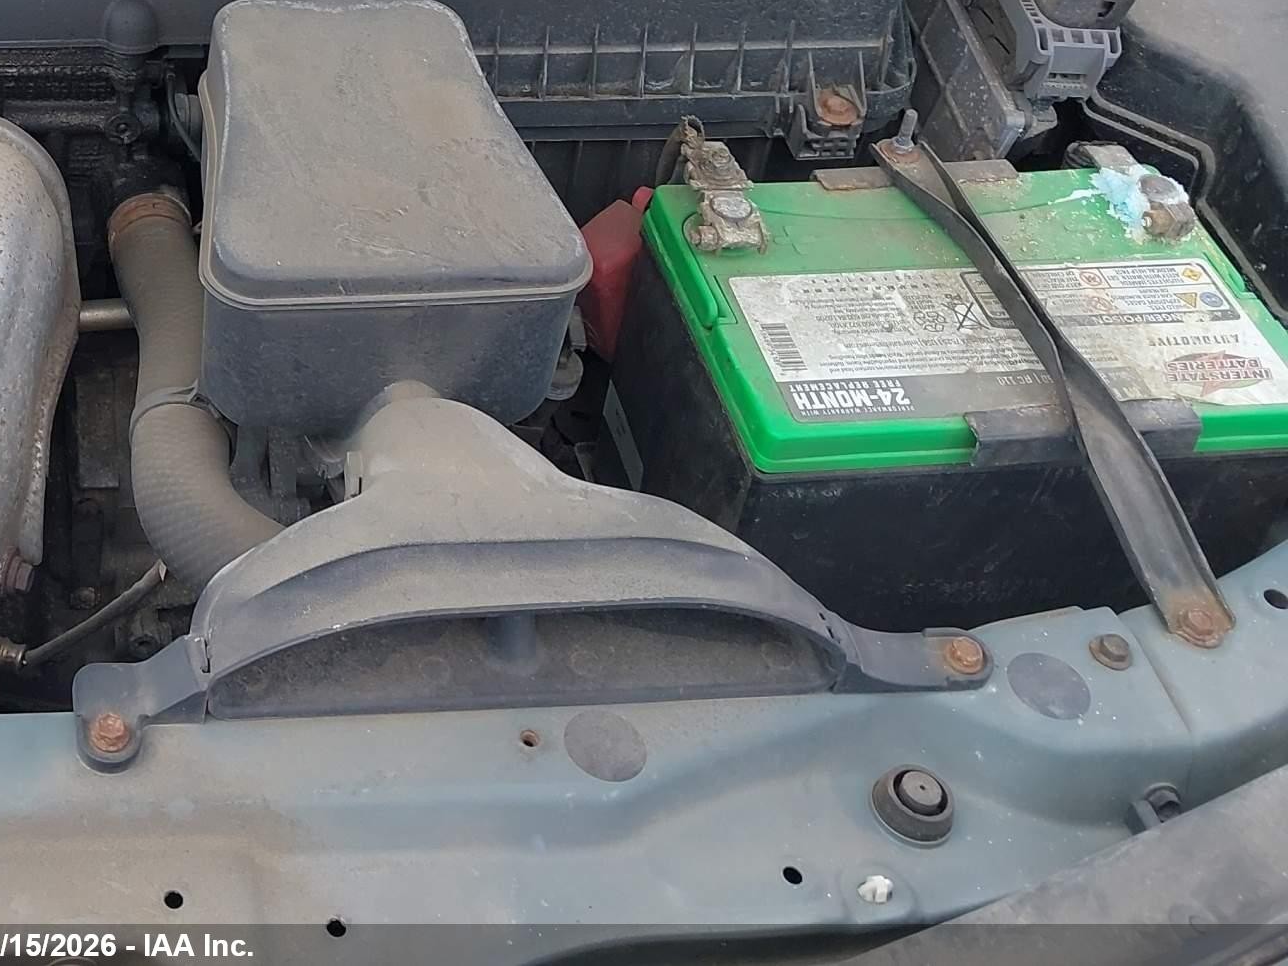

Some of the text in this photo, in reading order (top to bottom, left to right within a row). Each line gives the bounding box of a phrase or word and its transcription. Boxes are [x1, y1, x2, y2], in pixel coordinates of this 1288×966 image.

[1148, 333, 1240, 347] AUTOMOTIVE
[1166, 358, 1260, 371] BATTERIES
[1168, 370, 1270, 382] INTERSTATE
[788, 380, 902, 392] FREE REPLACEMENT
[792, 387, 911, 411] 24-MONTH
[800, 409, 820, 417] WITH
